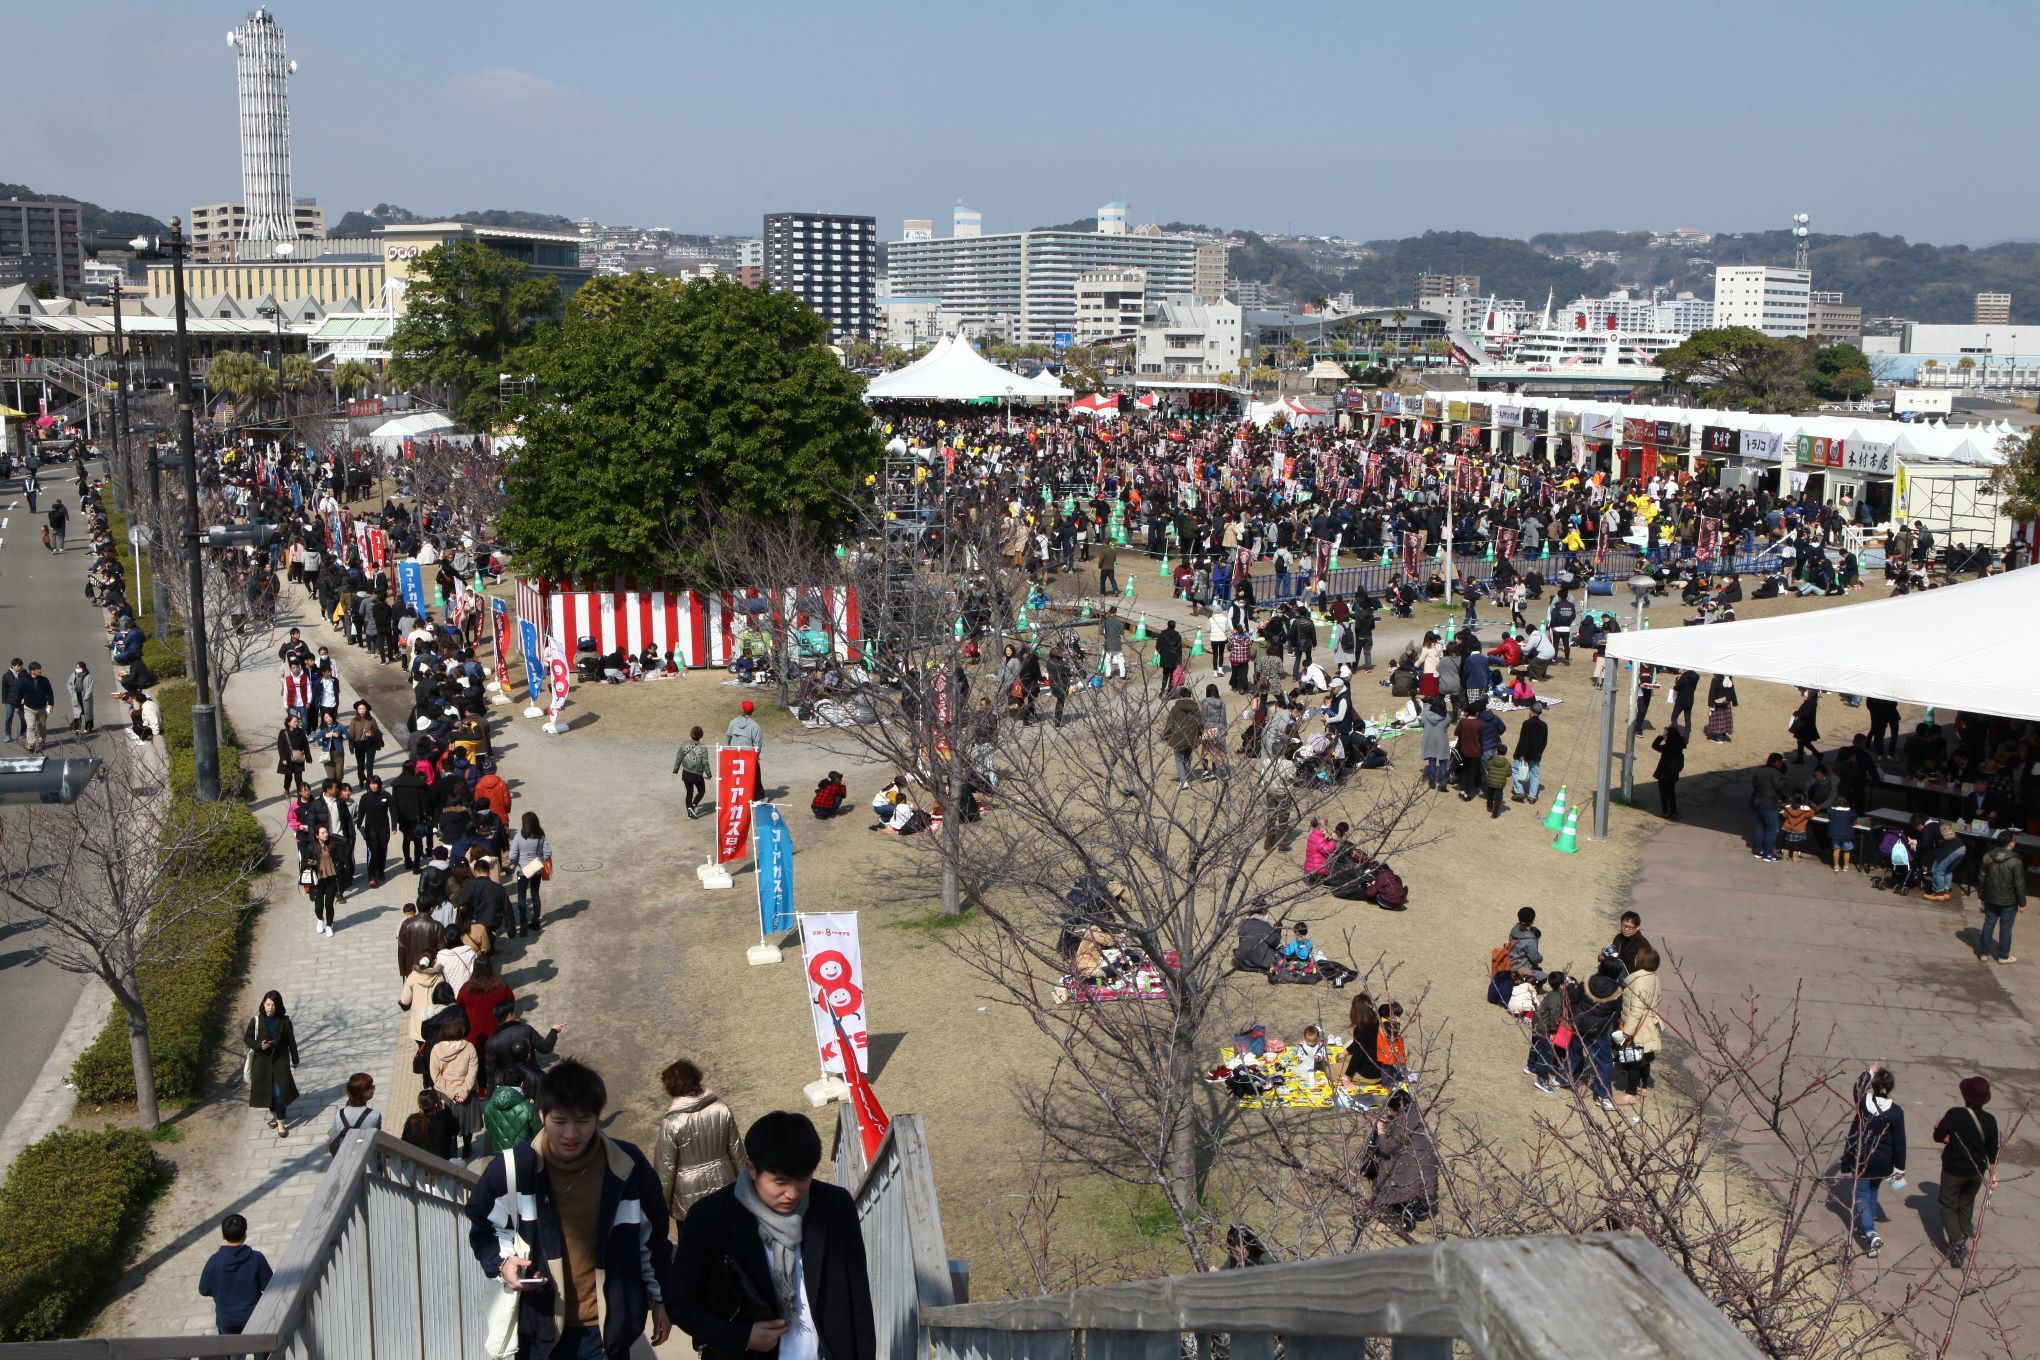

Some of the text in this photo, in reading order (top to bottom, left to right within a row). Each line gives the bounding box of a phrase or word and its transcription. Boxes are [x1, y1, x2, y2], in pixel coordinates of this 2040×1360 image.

[1713, 431, 1731, 447] 金斗雲
[1747, 439, 1766, 451] トラノコ
[1848, 450, 1888, 470] 木村本店
[723, 760, 745, 855] コーアガス日本
[821, 1030, 868, 1062] KS
